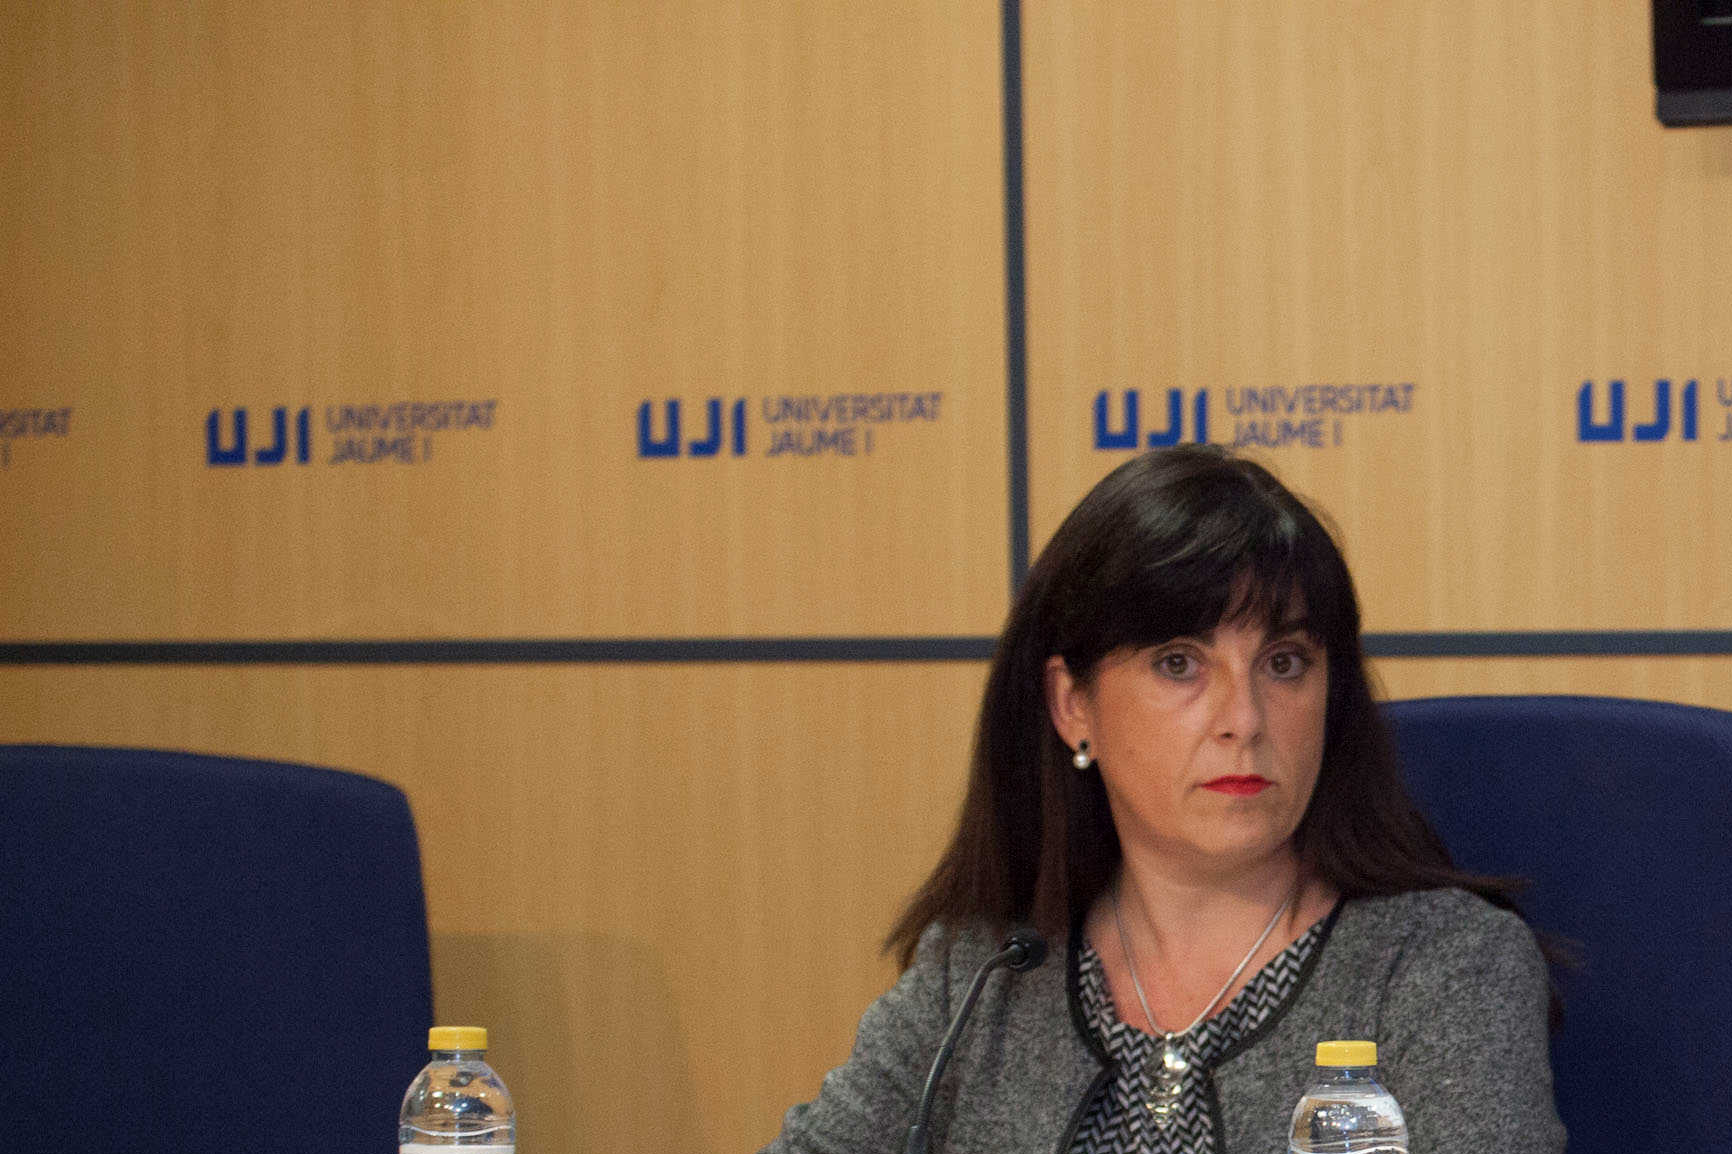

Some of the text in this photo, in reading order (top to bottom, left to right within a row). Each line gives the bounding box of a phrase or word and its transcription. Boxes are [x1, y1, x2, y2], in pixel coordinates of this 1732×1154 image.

[762, 392, 942, 422] UNIVERSITAT
[1226, 383, 1414, 415] UNIVERSITAT
[1577, 378, 1698, 443] UJI
[326, 402, 497, 432] UNIVERSITAT
[637, 397, 747, 458] UJI
[1093, 387, 1209, 449] UJI
[206, 407, 311, 466] UJI
[766, 428, 875, 457] JAUME I
[1232, 419, 1342, 448] JAUME I
[329, 435, 432, 464] JAUME I
